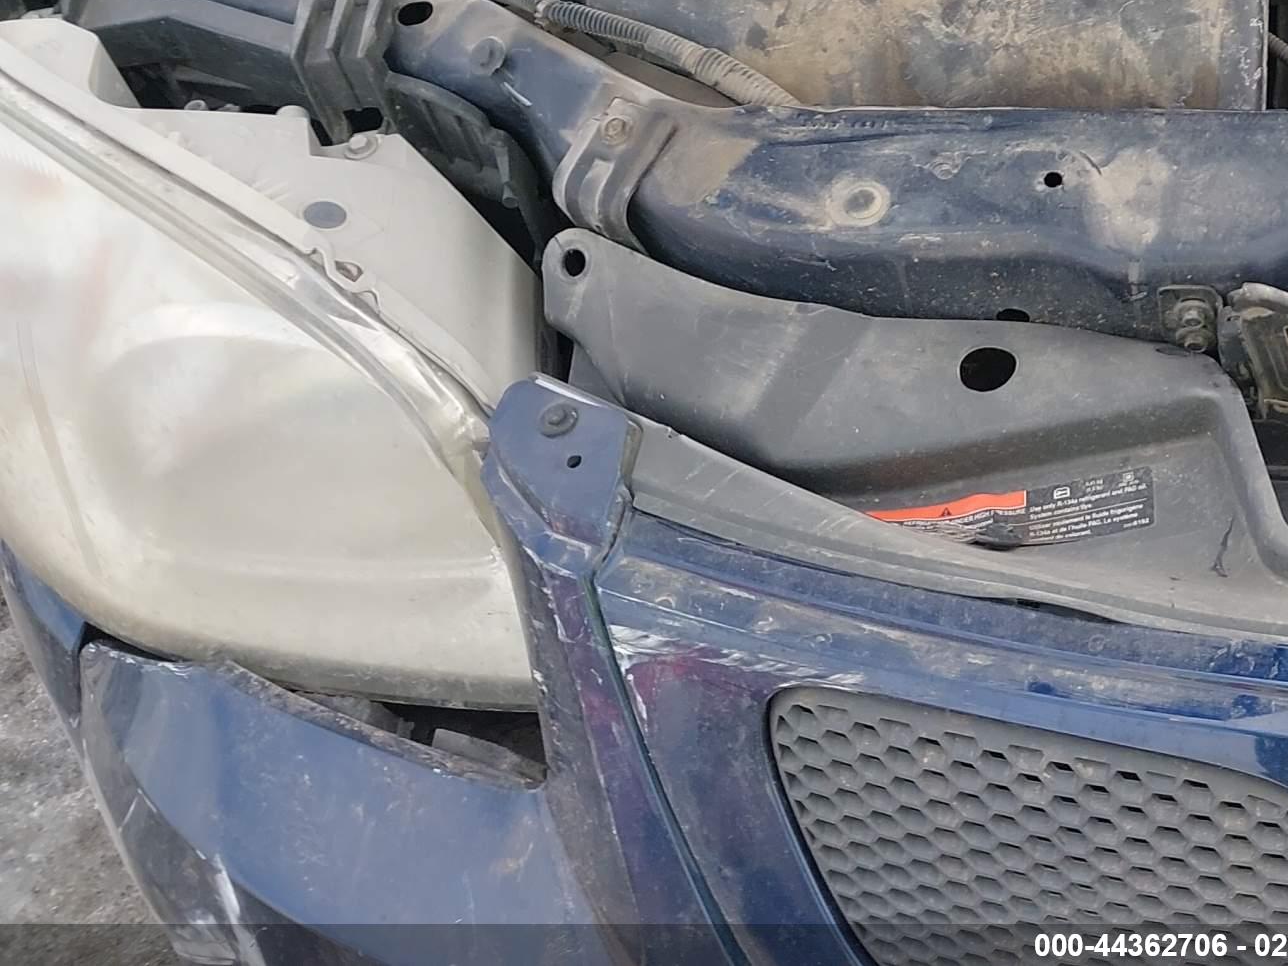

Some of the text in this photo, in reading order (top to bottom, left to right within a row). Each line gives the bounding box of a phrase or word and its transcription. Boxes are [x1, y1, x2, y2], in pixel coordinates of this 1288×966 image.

[1043, 502, 1056, 510] only
[1056, 498, 1078, 507] R-134a
[1112, 488, 1123, 496] and
[1030, 511, 1053, 520] System
